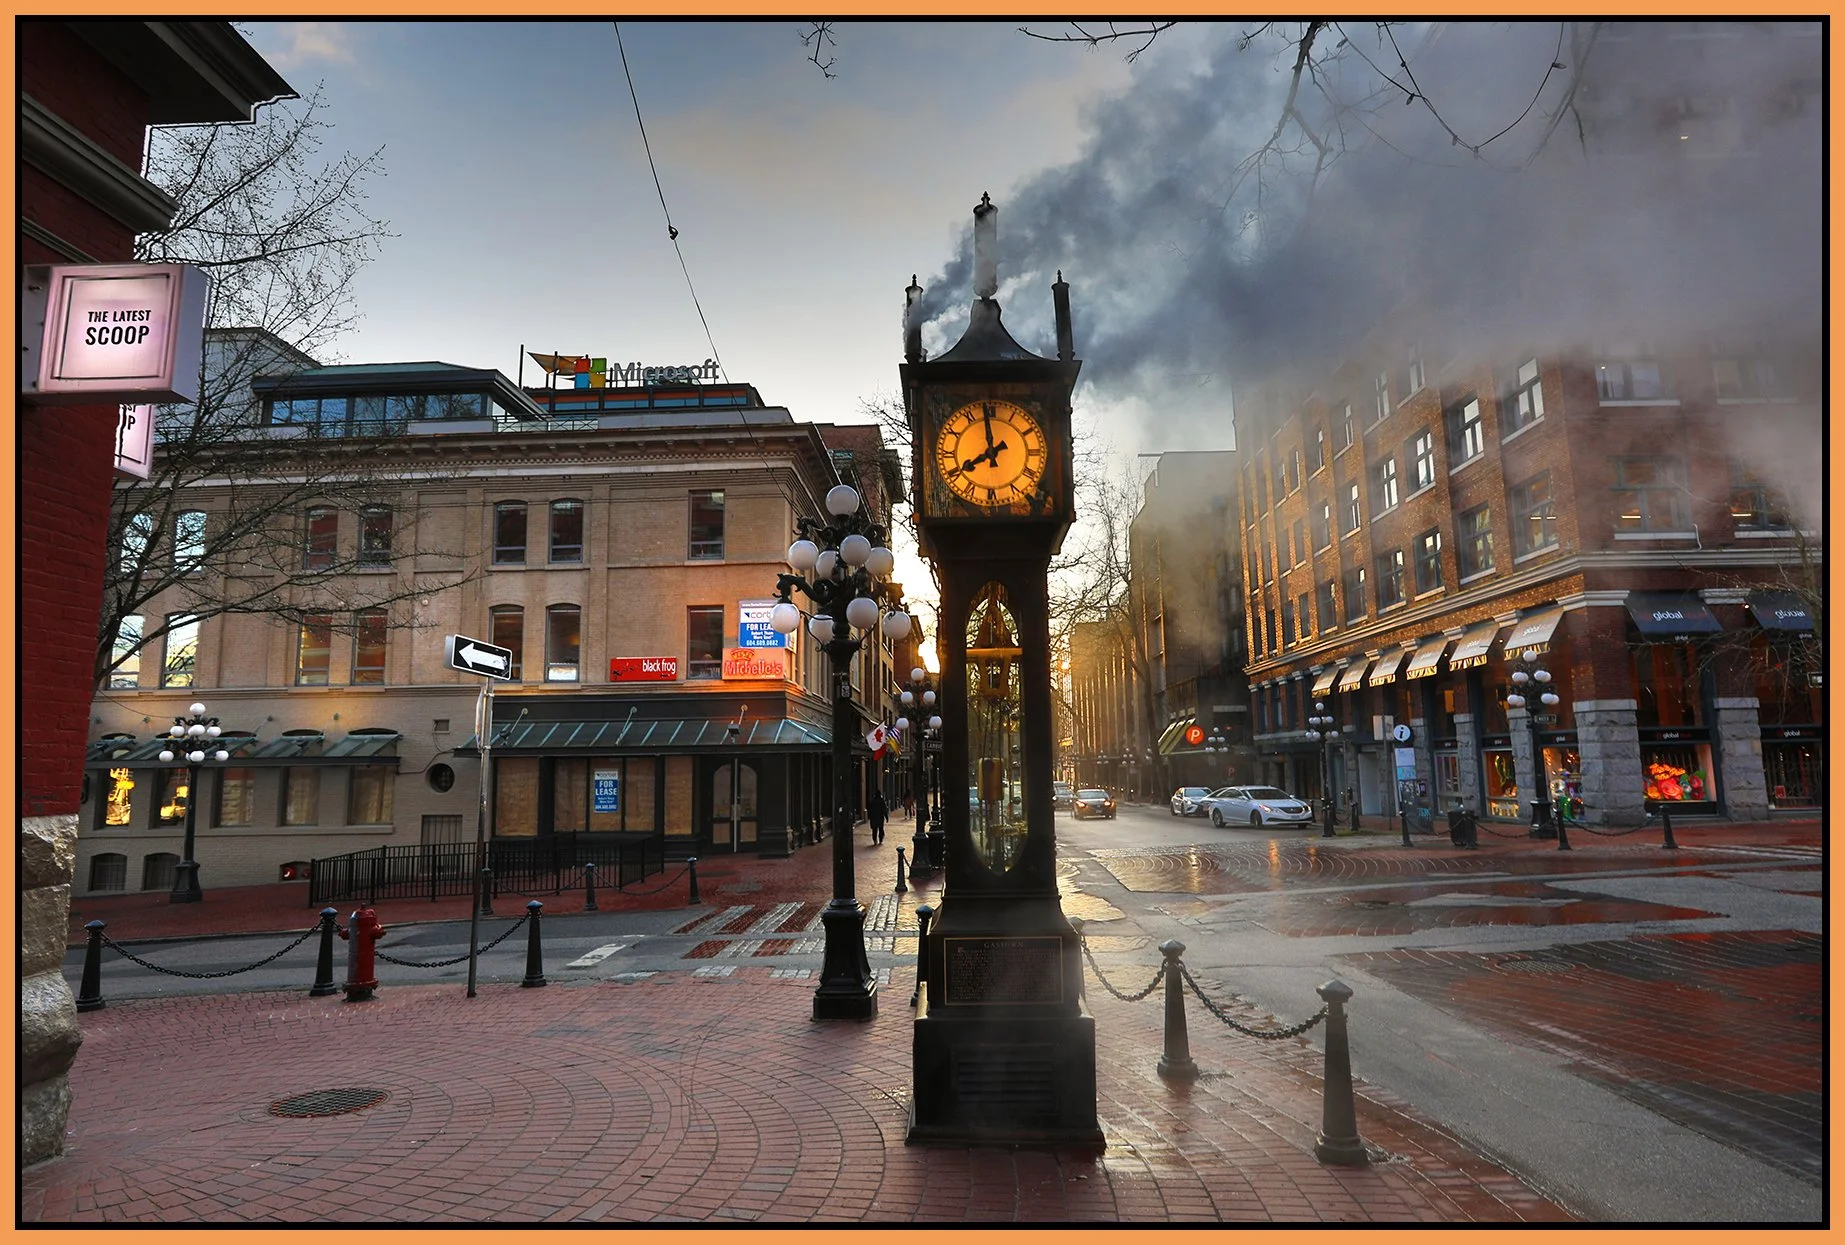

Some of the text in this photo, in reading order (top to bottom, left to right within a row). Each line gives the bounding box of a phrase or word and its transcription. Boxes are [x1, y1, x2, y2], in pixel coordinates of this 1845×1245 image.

[88, 310, 151, 322] THE LATEST
[85, 325, 150, 345] SCOOP
[614, 358, 719, 380] Microsoft
[1653, 610, 1684, 621] global
[746, 623, 774, 631] FOR LEA
[642, 658, 676, 675] black frog
[725, 660, 782, 675] Michelle's
[1190, 729, 1201, 742] P
[599, 780, 614, 788] FOR
[595, 788, 617, 796] LEASE
